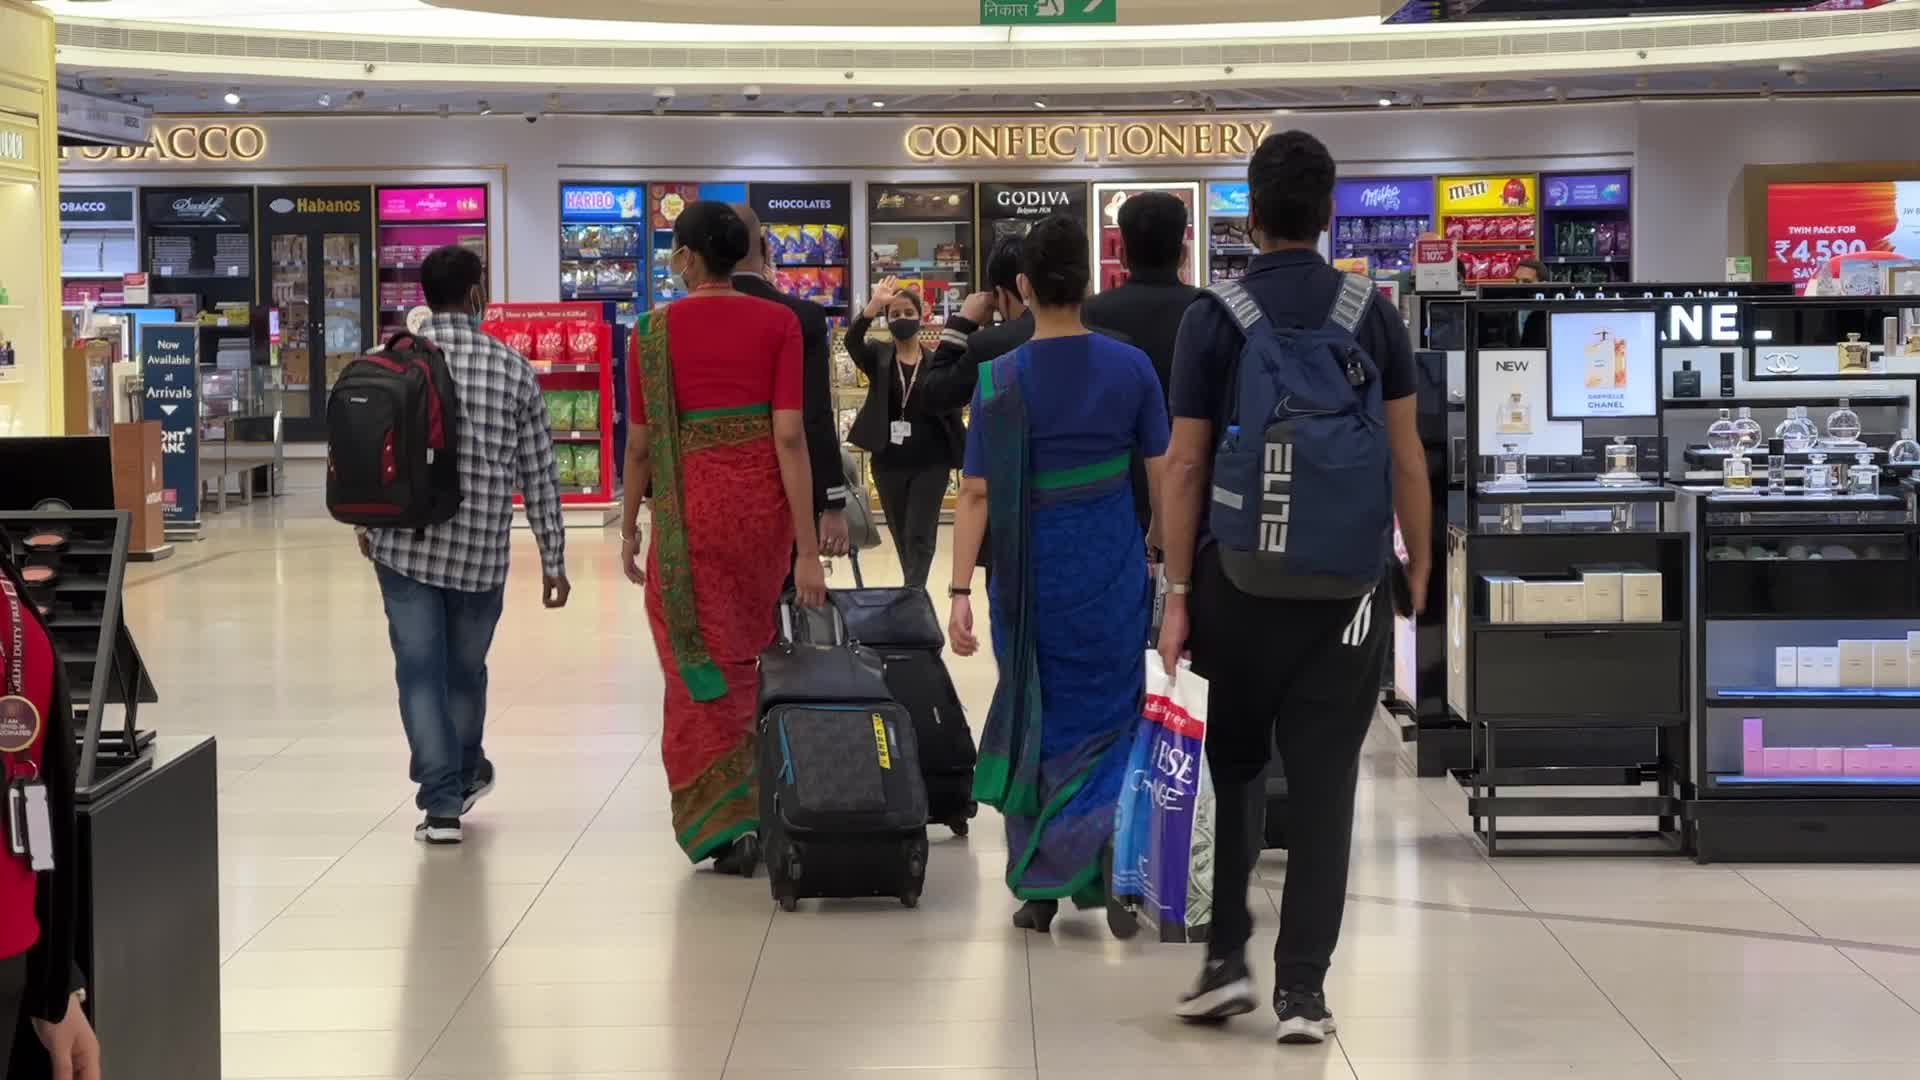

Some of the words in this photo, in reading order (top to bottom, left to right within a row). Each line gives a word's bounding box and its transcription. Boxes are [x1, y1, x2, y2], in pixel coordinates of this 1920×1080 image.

[907, 124, 1271, 158] CONFECTIONERY
[566, 192, 614, 208] HARIBO
[997, 191, 1069, 205] GODIVA
[60, 201, 105, 212] OBACCO
[297, 198, 360, 213] Habanos
[768, 199, 831, 209] CHOCOLATES
[1789, 226, 1811, 234] TWIN
[1813, 226, 1836, 234] PACK
[1838, 225, 1857, 233] FOR
[157, 340, 179, 350] Now
[147, 355, 191, 365] Available
[1495, 360, 1529, 373] NEW
[164, 373, 173, 381] at
[146, 385, 193, 398] Arrivals
[161, 431, 186, 442] ONT
[161, 442, 186, 453] ANC
[13, 625, 22, 657] DUTY
